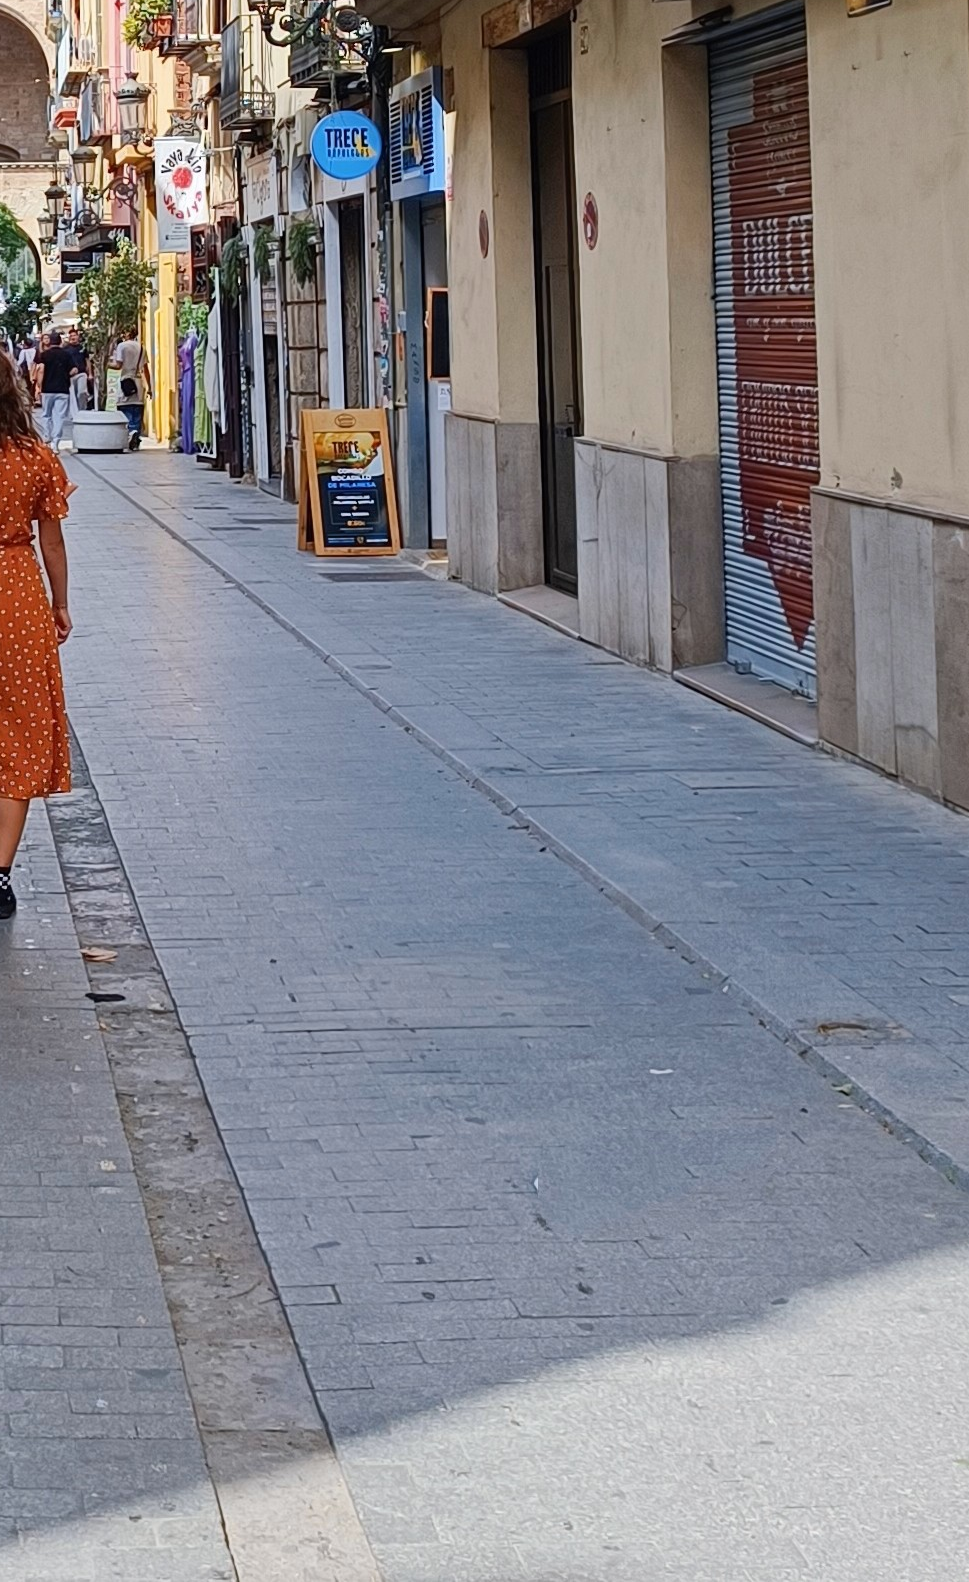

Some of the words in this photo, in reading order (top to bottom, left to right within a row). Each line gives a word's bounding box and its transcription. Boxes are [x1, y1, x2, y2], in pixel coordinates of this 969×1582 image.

[324, 127, 369, 148] TRECE
[161, 149, 183, 174] Vaya
[163, 191, 203, 220] Skalya
